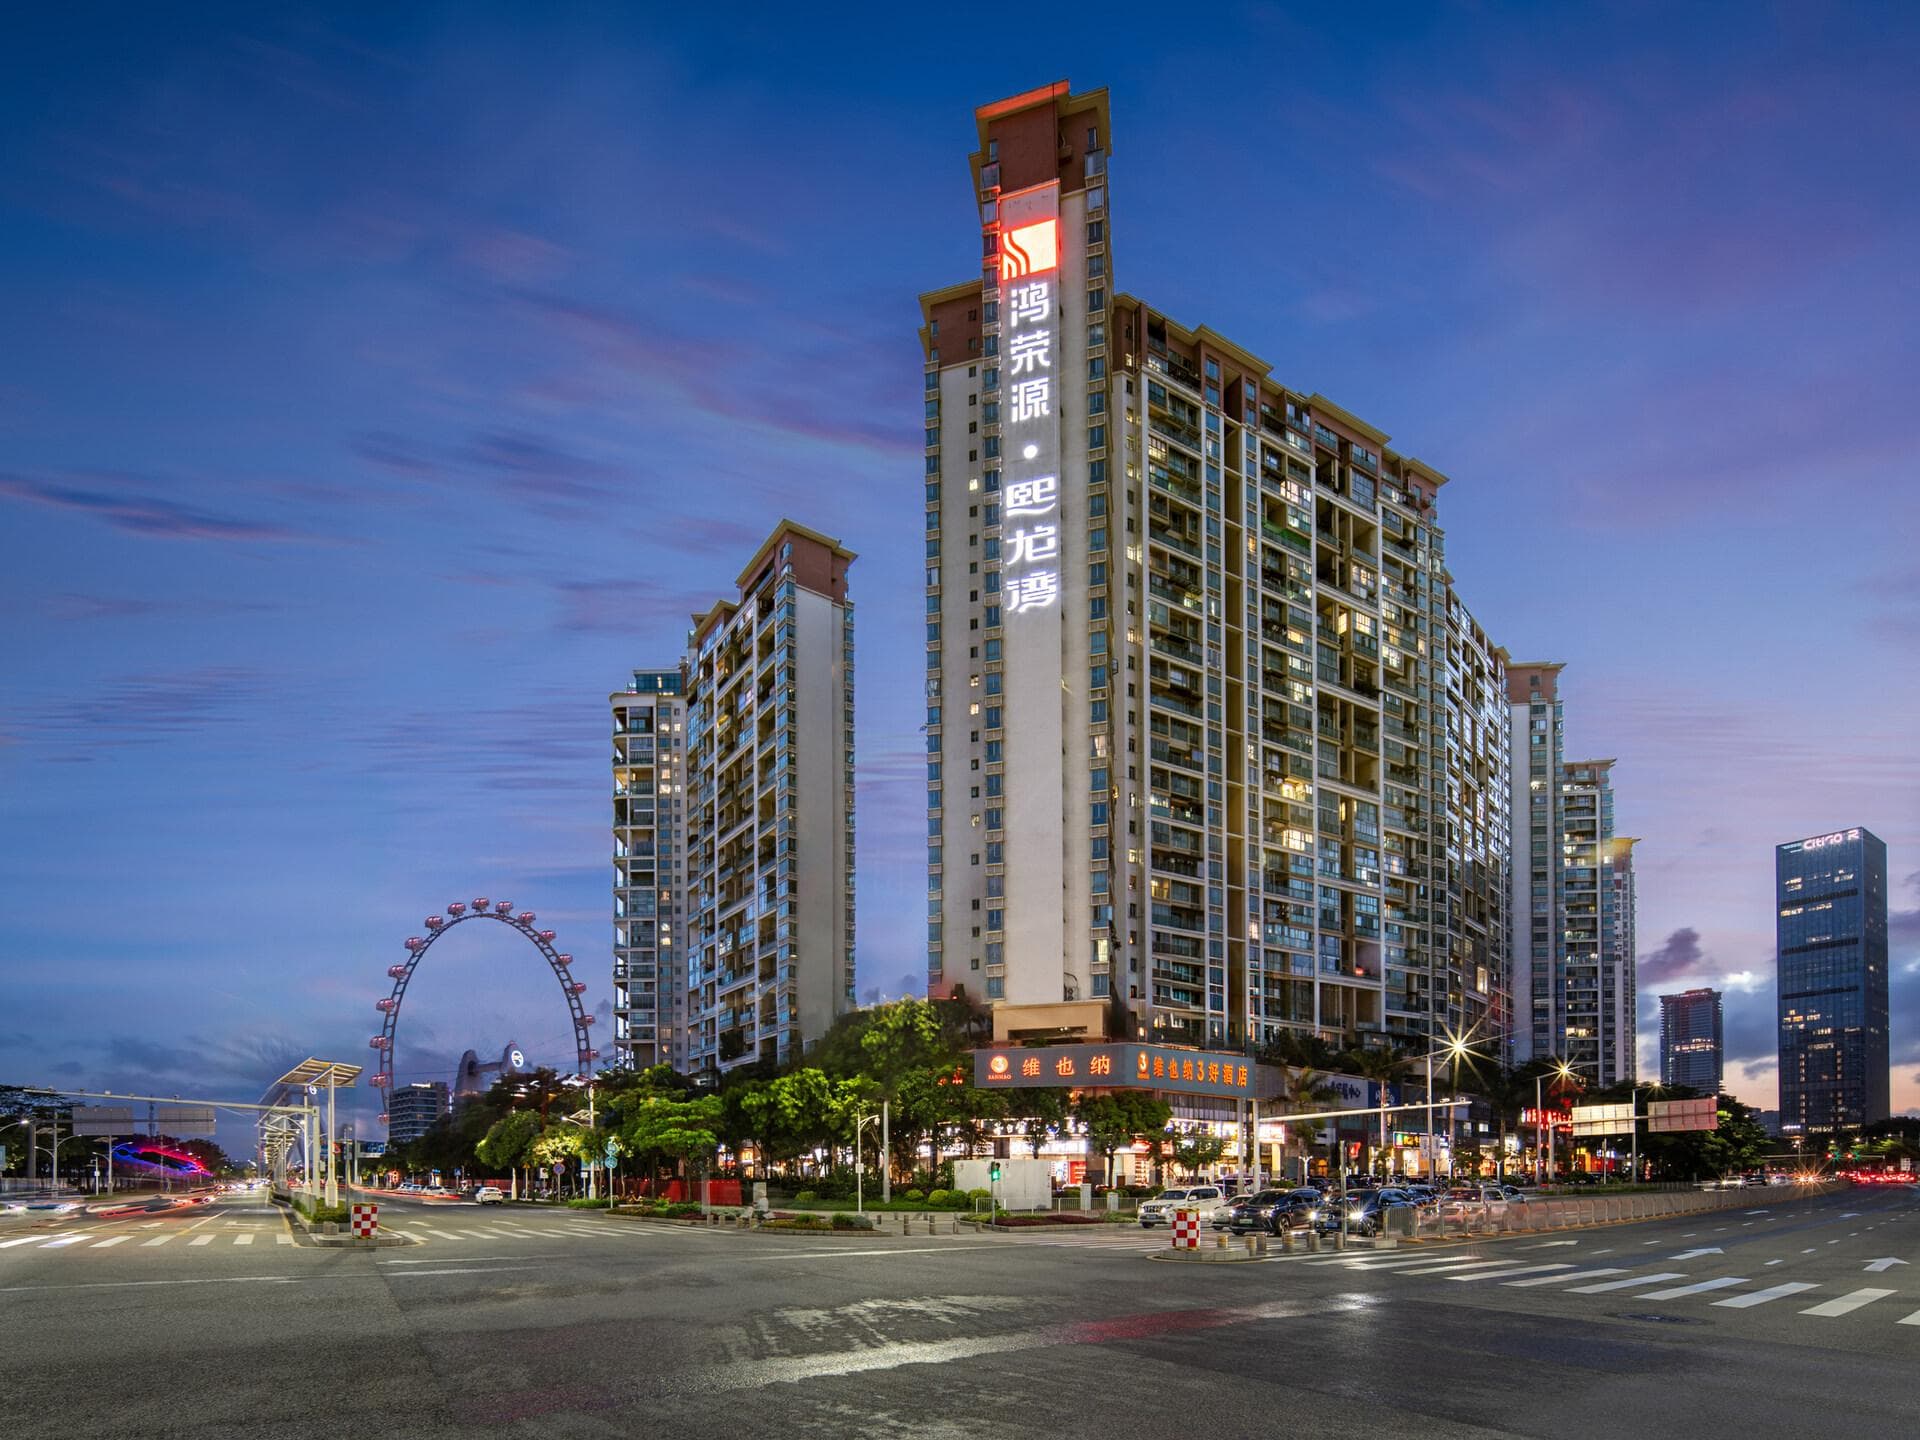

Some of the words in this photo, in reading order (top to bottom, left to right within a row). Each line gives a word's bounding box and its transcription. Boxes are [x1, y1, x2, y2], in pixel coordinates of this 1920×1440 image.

[1022, 1055, 1111, 1077] 维也纳
[1153, 1056, 1248, 1088] 维也纳3好酒店
